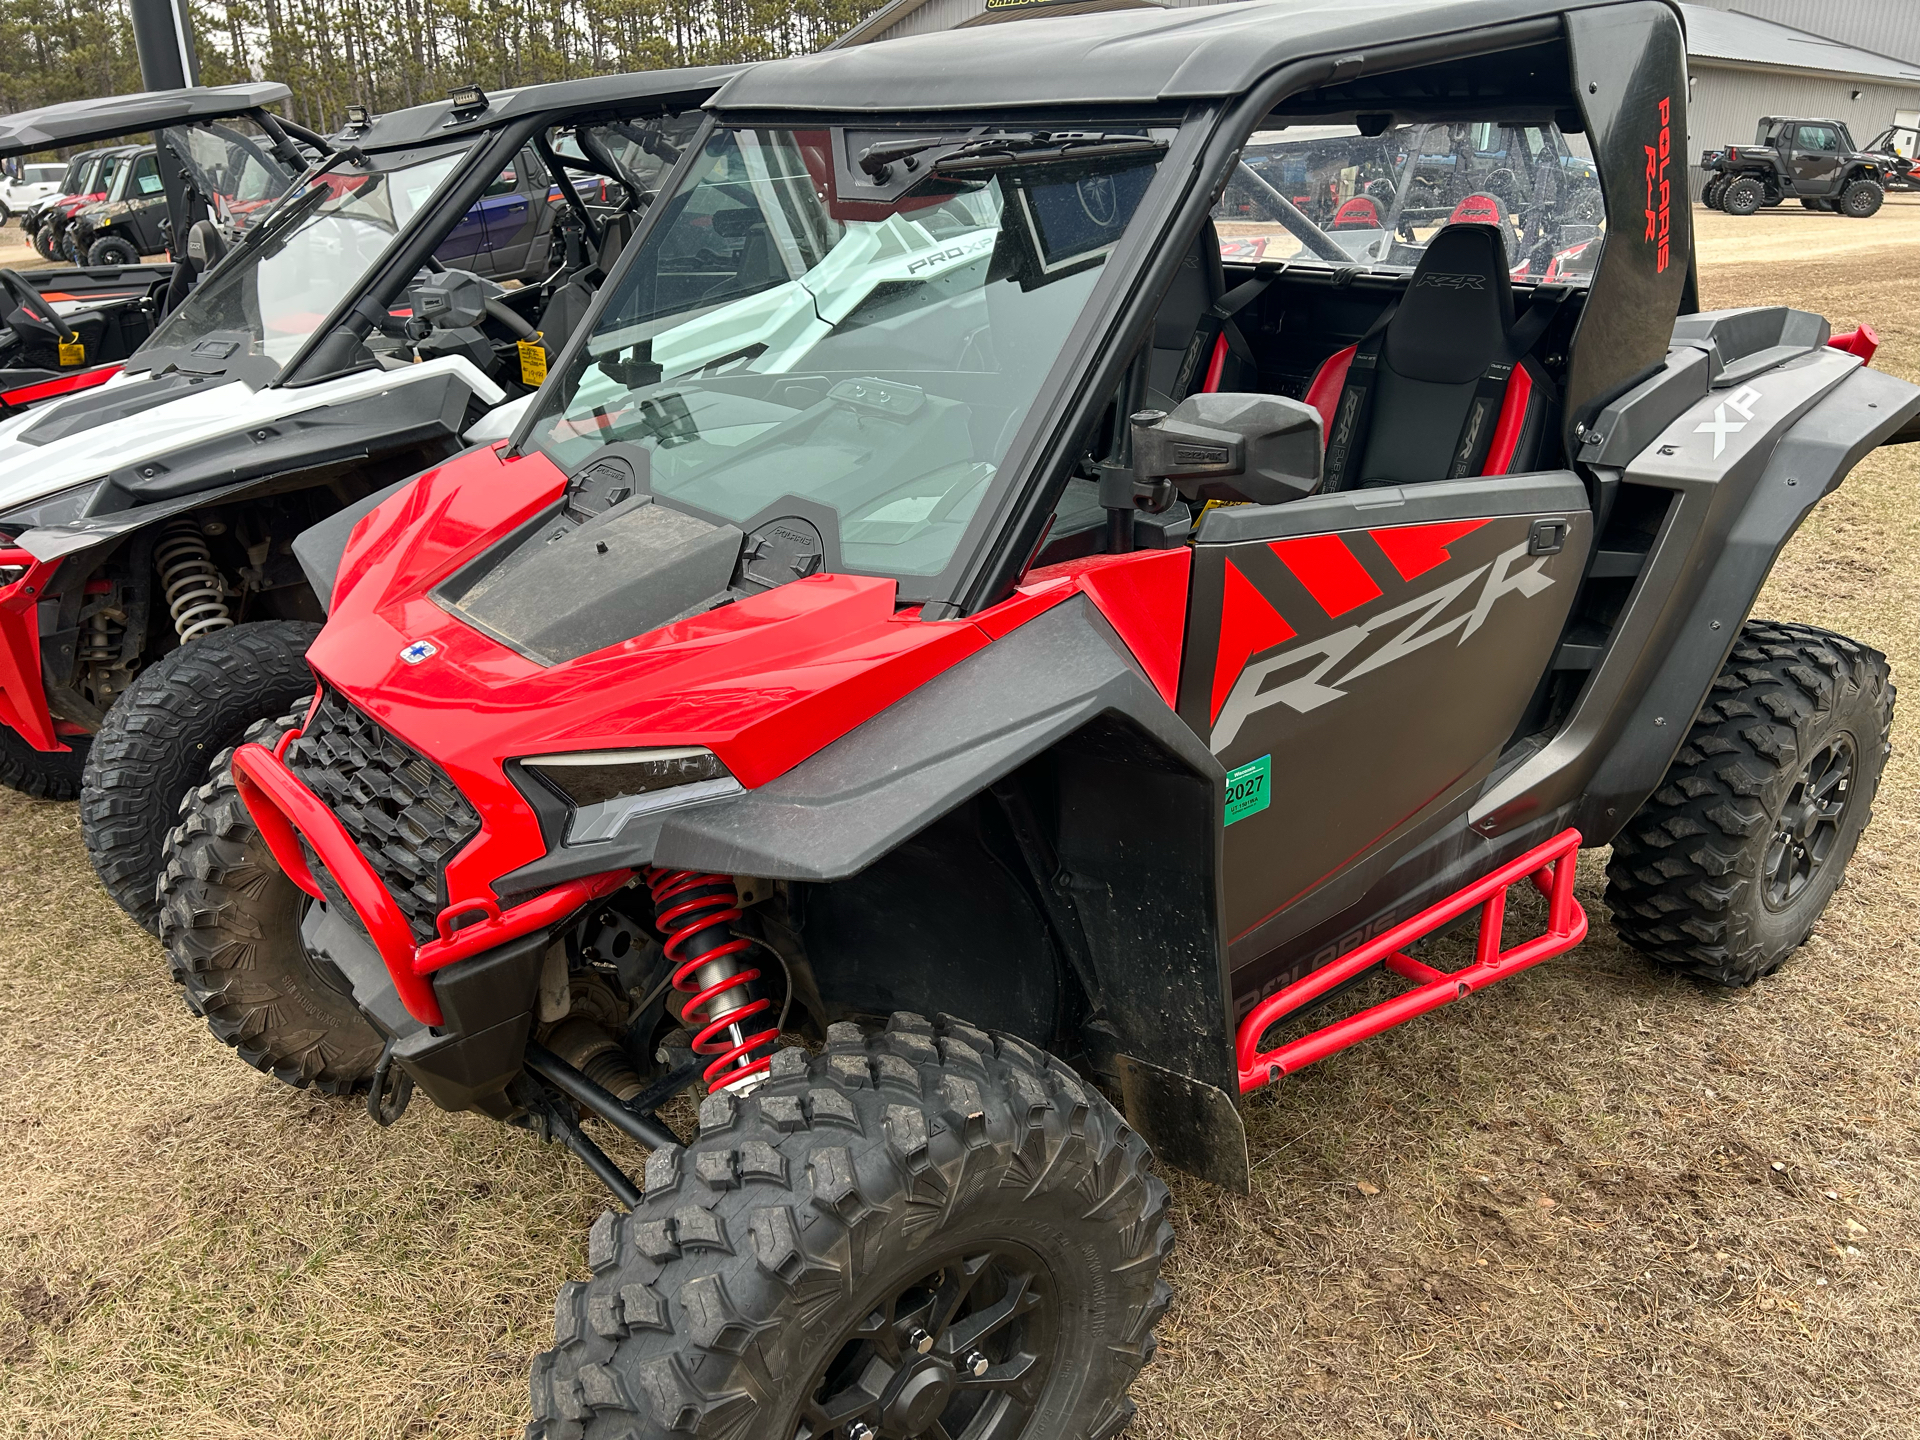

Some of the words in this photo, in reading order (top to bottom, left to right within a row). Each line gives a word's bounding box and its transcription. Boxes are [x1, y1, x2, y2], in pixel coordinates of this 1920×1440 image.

[1657, 96, 1670, 273] POLARIS
[1458, 208, 1492, 217] RZR
[906, 246, 965, 275] PRO
[963, 237, 993, 254] XP
[1416, 272, 1487, 290] RZR
[1336, 389, 1359, 445] RZR
[1460, 402, 1485, 460] RZR
[1692, 384, 1763, 461] XP
[1178, 450, 1223, 461] SEIZMIK
[596, 467, 625, 481] POLARIS
[774, 529, 812, 546] POLARIS
[1210, 522, 1571, 756] RZR
[1225, 774, 1264, 805] 2027
